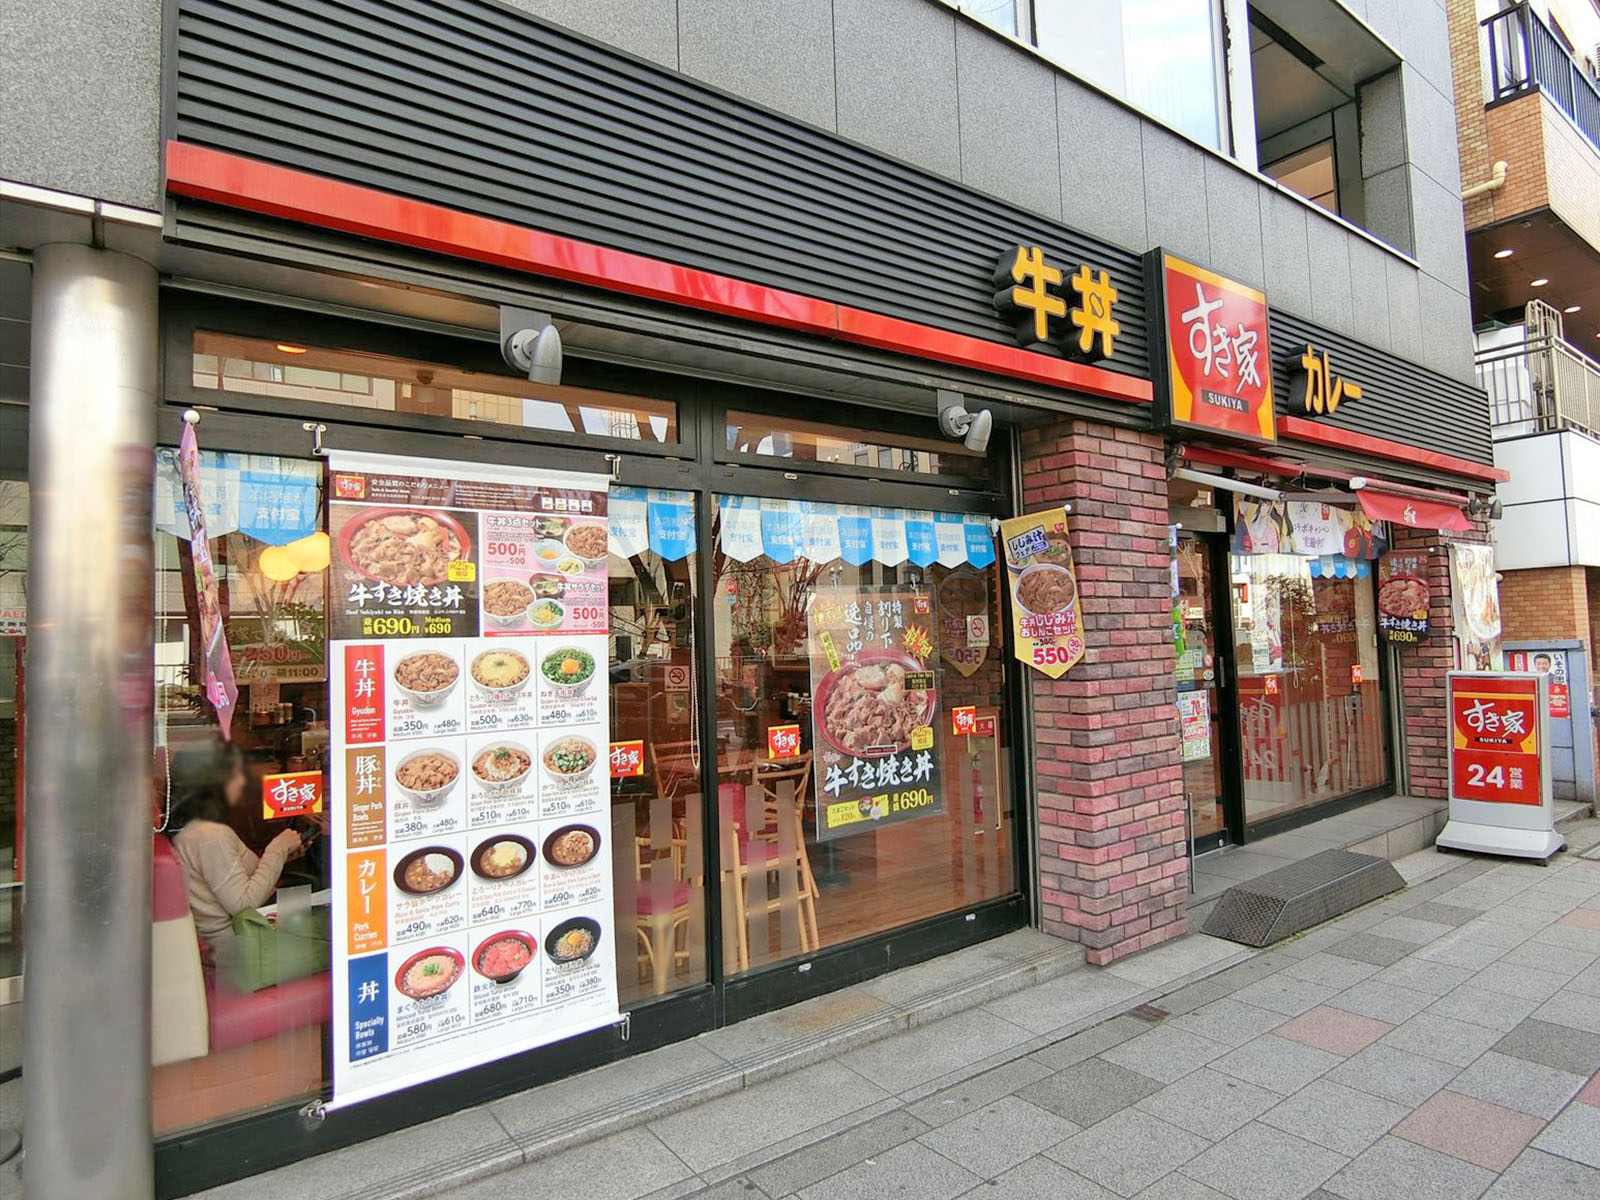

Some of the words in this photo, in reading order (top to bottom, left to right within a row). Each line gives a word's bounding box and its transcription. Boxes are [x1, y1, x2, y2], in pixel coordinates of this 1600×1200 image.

[1010, 245, 1121, 358] 牛丼
[1181, 282, 1262, 394] すき家
[1301, 343, 1362, 414] カレー
[1208, 392, 1243, 411] SUKIYA
[348, 580, 464, 608] 牛すき焼き丼
[354, 659, 376, 698] 牛丼
[1463, 699, 1525, 737] すき家
[271, 778, 316, 805] すき家
[355, 754, 377, 795] 豚丼
[824, 750, 934, 798] 牛すき焼き丼
[1467, 764, 1504, 789] 24
[358, 859, 377, 914] カレー
[357, 980, 379, 1004] 丼
